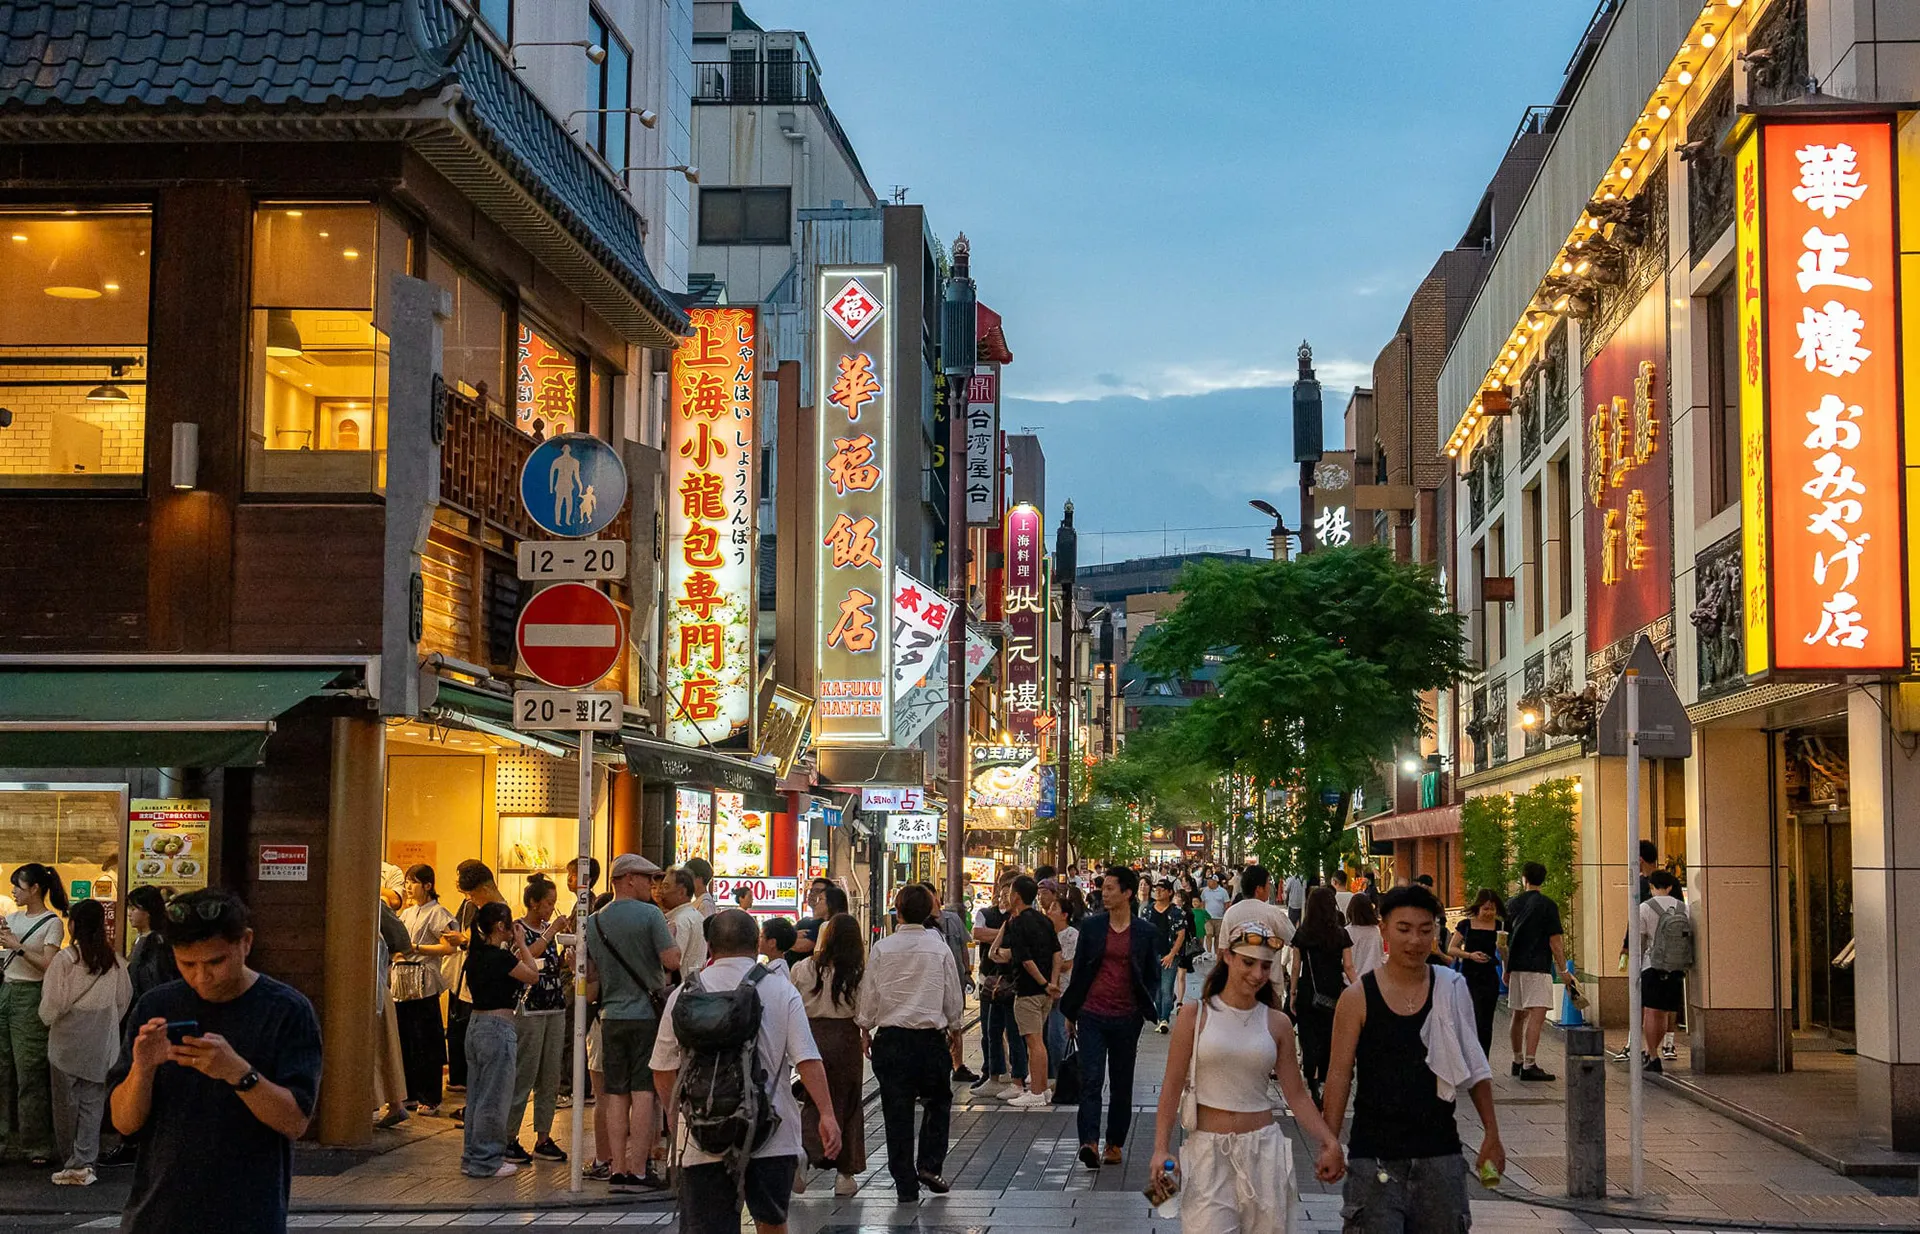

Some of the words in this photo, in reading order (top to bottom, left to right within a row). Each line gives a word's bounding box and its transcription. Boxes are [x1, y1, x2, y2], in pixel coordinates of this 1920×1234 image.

[1792, 143, 1873, 377] 華正樓
[733, 326, 755, 420] しゃんはい
[966, 408, 992, 503] 台湾屋台
[731, 430, 754, 565] しょうろんぽう
[824, 352, 883, 652] 華福飯店
[1802, 394, 1872, 649] おみやげ店
[1016, 519, 1031, 578] 上海料理
[894, 584, 949, 631] 本店
[820, 681, 882, 697] KAFUKU
[820, 700, 882, 716] HANTEN
[987, 746, 1033, 760] 王府井
[900, 788, 920, 810] 占
